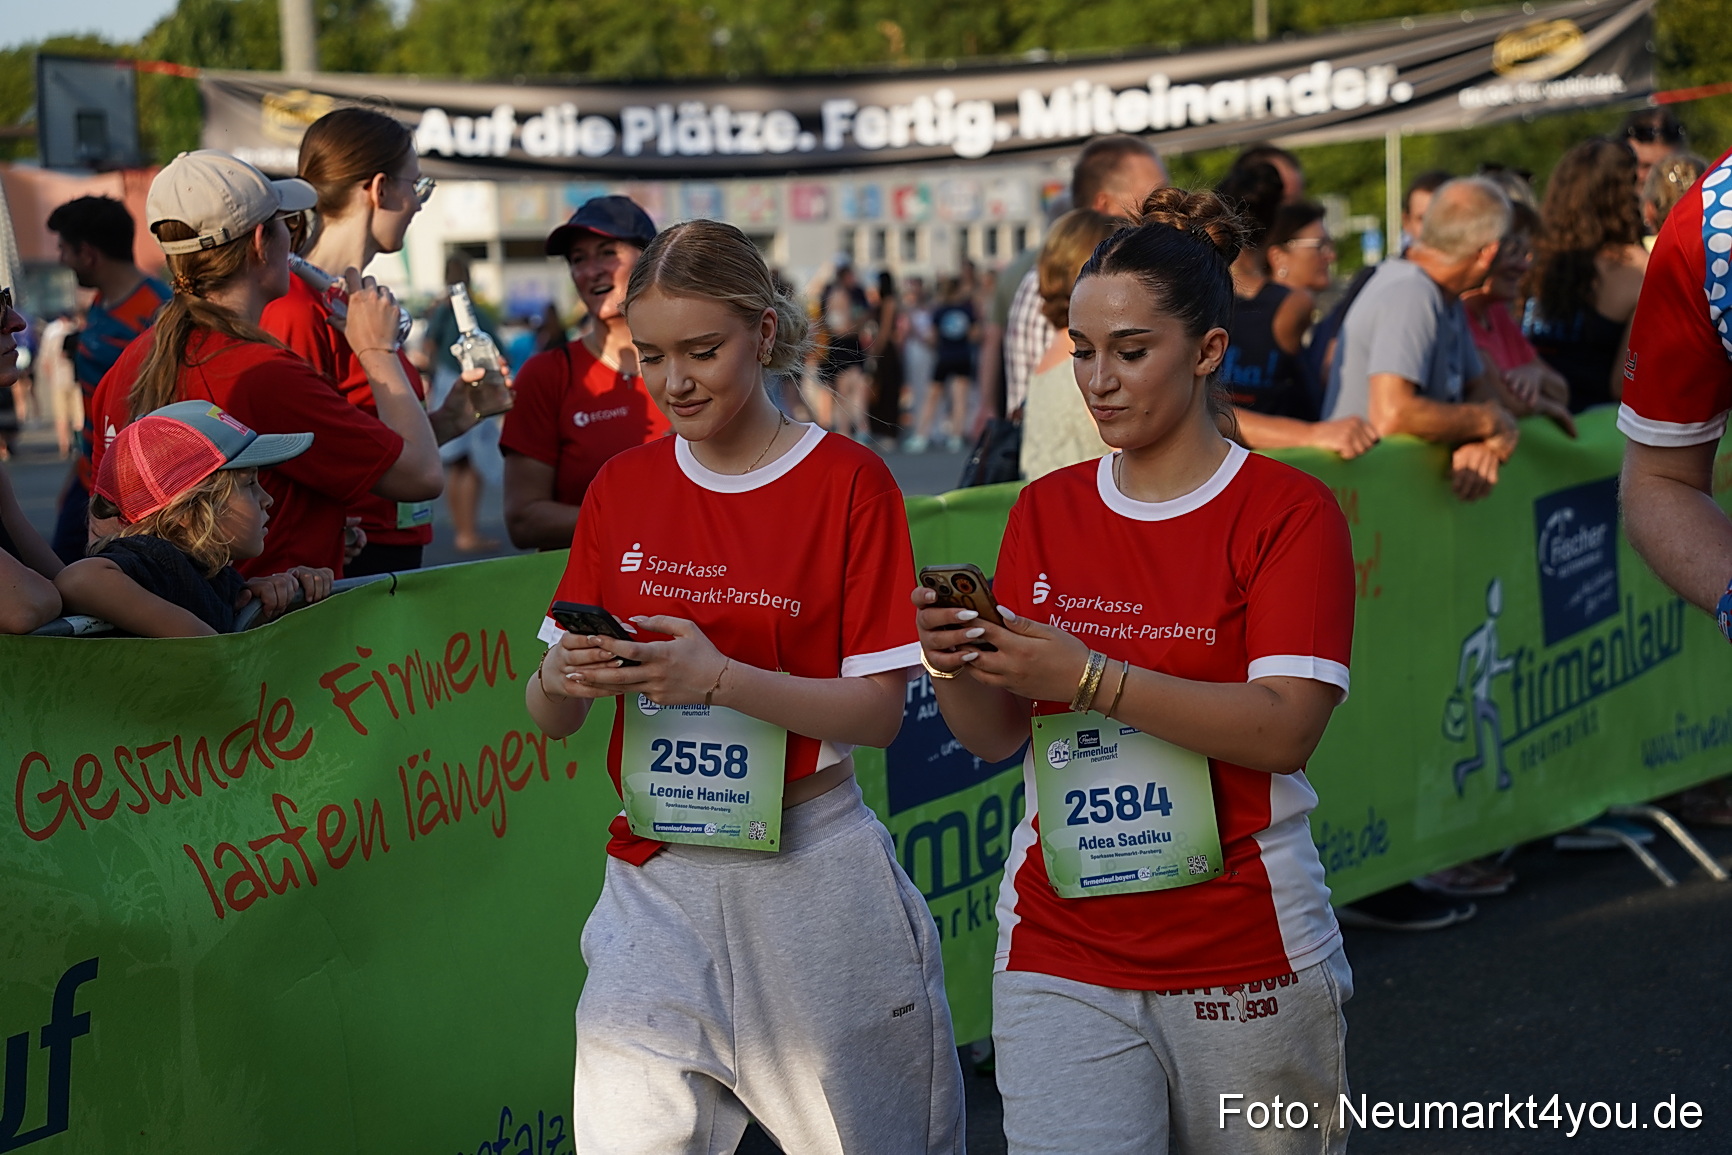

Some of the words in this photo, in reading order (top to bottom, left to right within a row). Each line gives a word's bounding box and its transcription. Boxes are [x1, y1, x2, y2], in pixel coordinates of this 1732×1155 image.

[416, 105, 515, 157] Auf
[520, 103, 616, 157] die
[620, 101, 817, 156] Plätze.
[821, 89, 1012, 159] Fertig.
[1017, 61, 1414, 139] Miteinander.
[590, 407, 628, 422] ECOVIS
[646, 556, 727, 578] Sparkasse
[640, 580, 801, 617] Neumarkt-Parsberg
[1055, 595, 1143, 614] Sparkasse
[1049, 614, 1216, 645] Neumarkt-Parsberg
[1512, 593, 1686, 734] firmenlauf
[917, 700, 938, 721] AU
[15, 682, 314, 841] Gesunde
[319, 629, 517, 737] Firmen
[651, 738, 748, 779] 2558
[1072, 743, 1118, 760] Firmenlauf
[1091, 754, 1118, 763] neumarkt
[650, 783, 693, 800] Leonie
[697, 787, 750, 804] Hanikel
[1065, 782, 1173, 826] 2584
[689, 804, 731, 813] Neumarkt-Parsberg
[183, 793, 390, 919] laufen
[398, 729, 578, 841] länger!
[655, 824, 703, 833] firmenlauf.bayern
[1079, 836, 1115, 851] Adea
[1118, 830, 1172, 847] Sadiku
[1115, 849, 1162, 857] Neumarkt-Parsberg
[1083, 873, 1136, 886] firmenlauf.bayern
[1194, 1002, 1235, 1020] EST.
[1245, 997, 1278, 1019] 930
